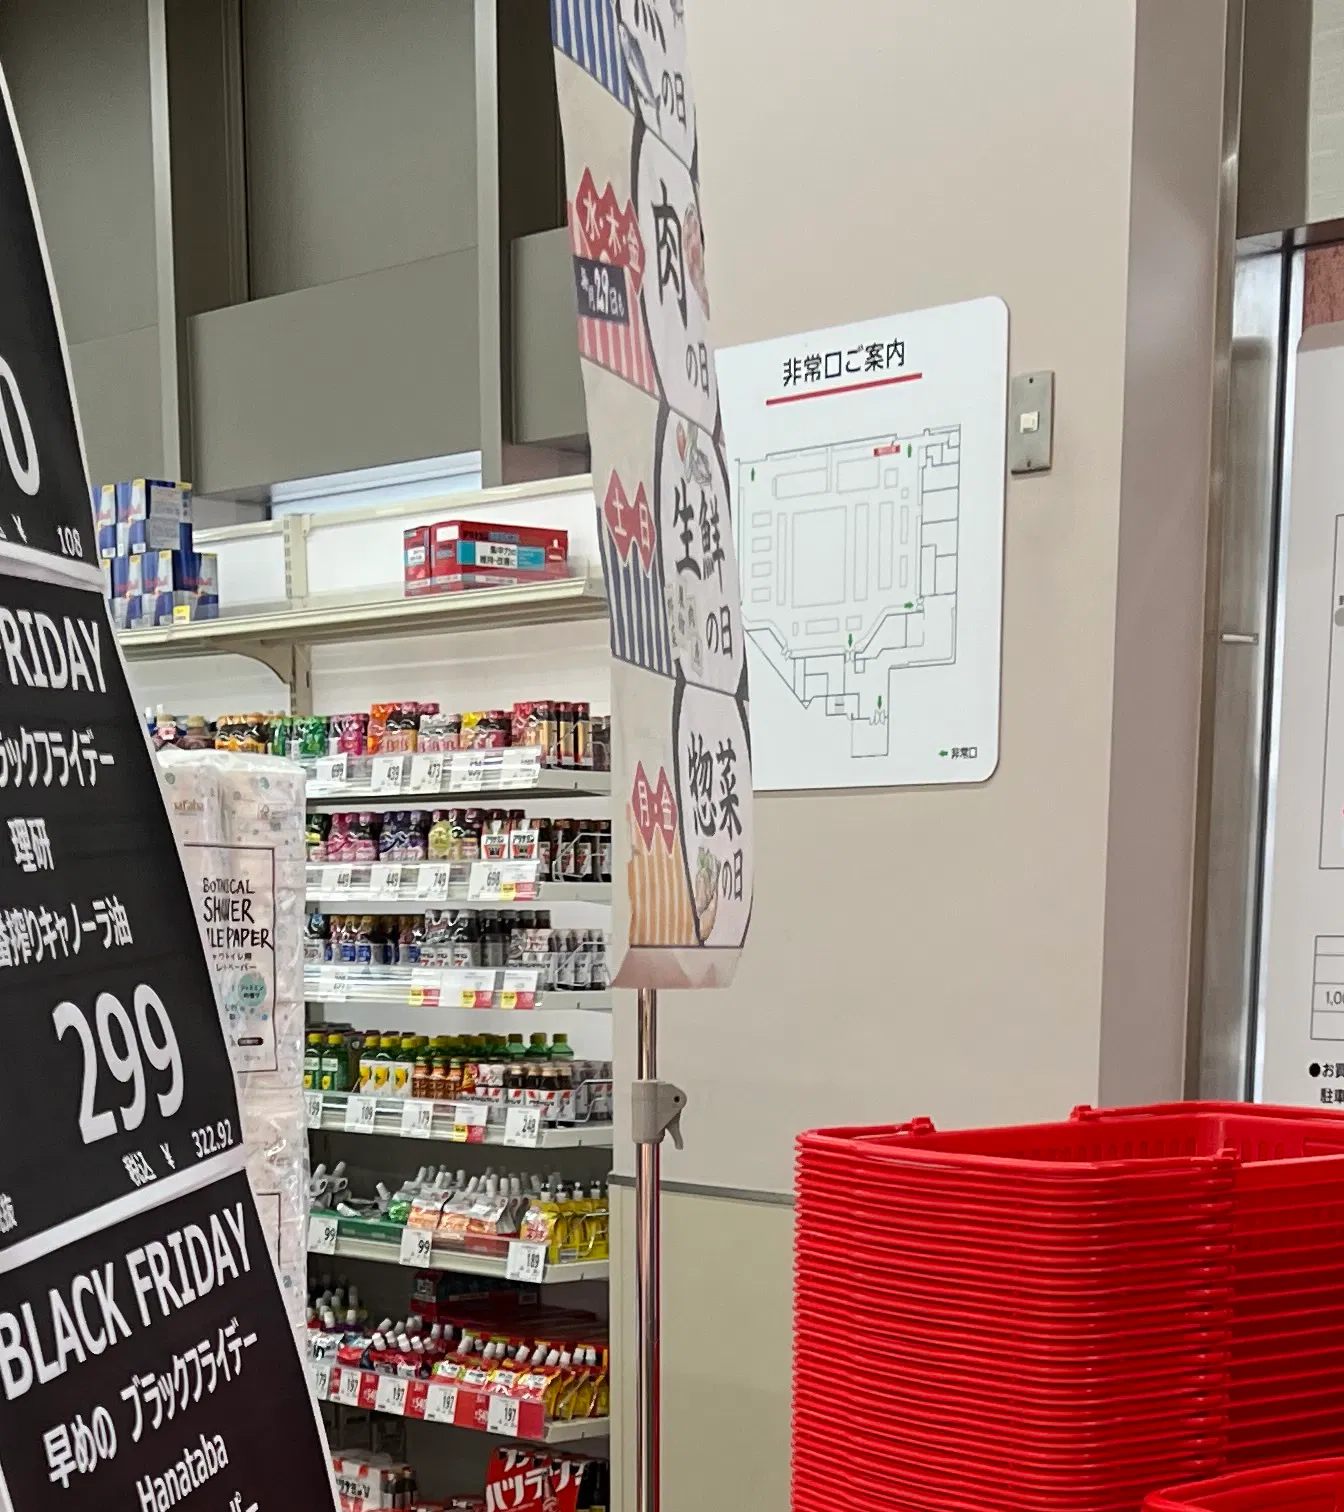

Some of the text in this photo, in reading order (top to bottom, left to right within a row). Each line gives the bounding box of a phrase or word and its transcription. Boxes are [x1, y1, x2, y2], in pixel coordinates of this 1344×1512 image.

[782, 337, 906, 388] 非常口ご案内
[56, 526, 84, 559] 108
[672, 477, 726, 595] 生鮮
[687, 731, 743, 842] 惣菜
[7, 816, 55, 875] 理研
[53, 983, 187, 1145] 299
[191, 1118, 234, 1160] 322.92
[324, 1226, 336, 1242] 99
[418, 1239, 430, 1254] 99
[125, 1201, 254, 1329] FRIDAY
[44, 1316, 260, 1490] 早めの ブラックフライデー
